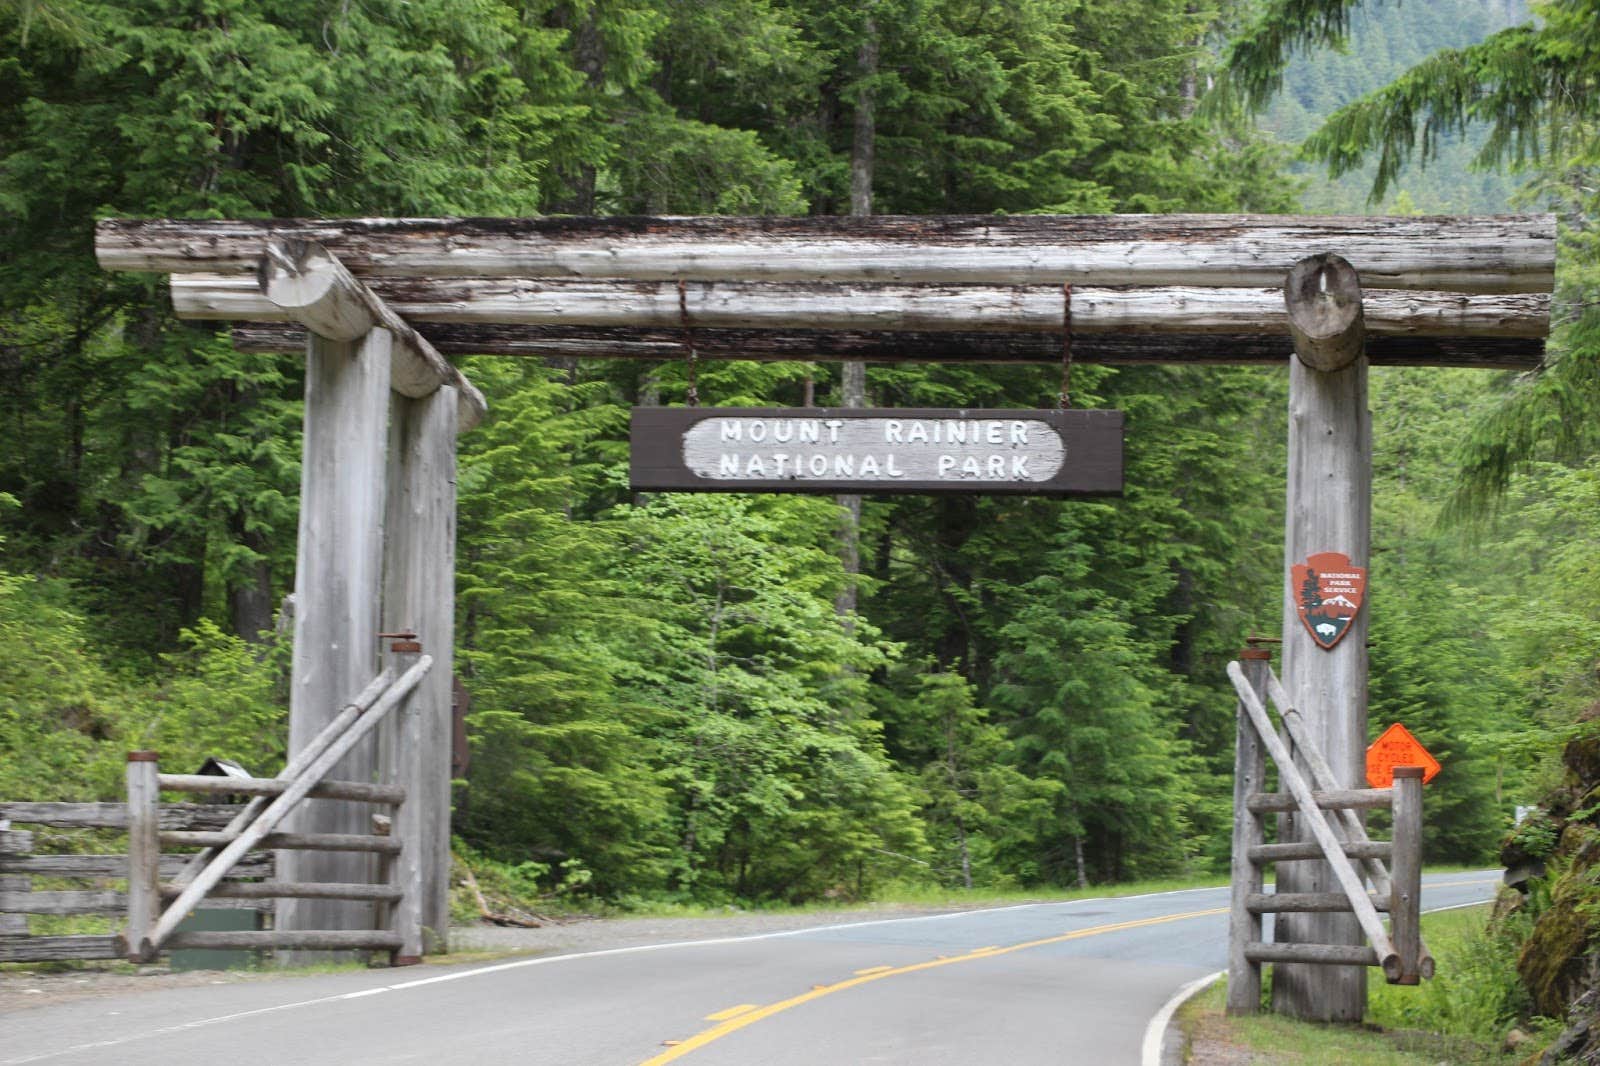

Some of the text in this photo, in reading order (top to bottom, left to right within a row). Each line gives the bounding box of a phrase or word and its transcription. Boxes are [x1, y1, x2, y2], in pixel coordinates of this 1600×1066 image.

[720, 420, 1028, 444] MOUNT RAINIER
[720, 453, 1030, 478] NATIONAL PARK
